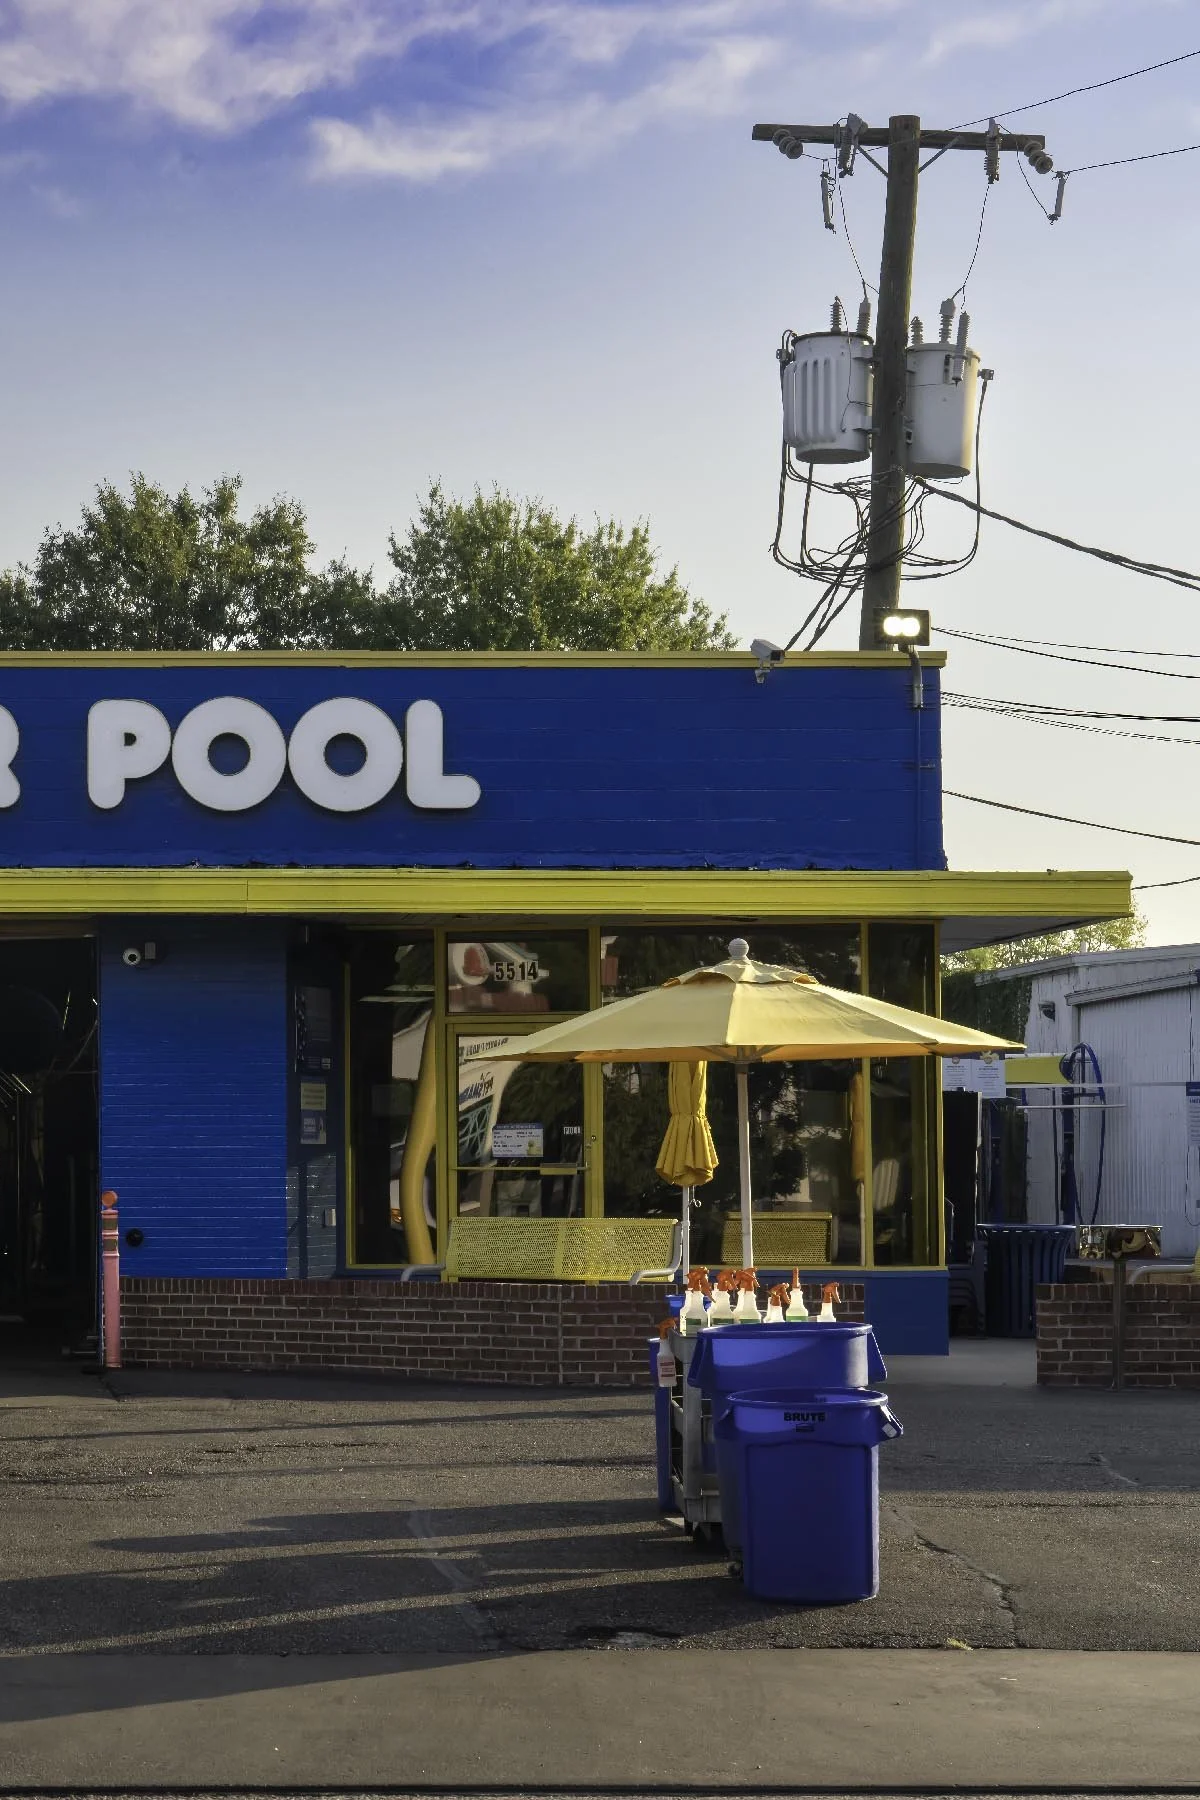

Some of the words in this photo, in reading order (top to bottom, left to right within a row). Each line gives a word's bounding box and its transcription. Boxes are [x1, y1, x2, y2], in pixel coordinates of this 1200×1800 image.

[87, 697, 481, 811] POOL
[495, 961, 537, 981] 5514
[784, 1411, 826, 1422] BRUTE
